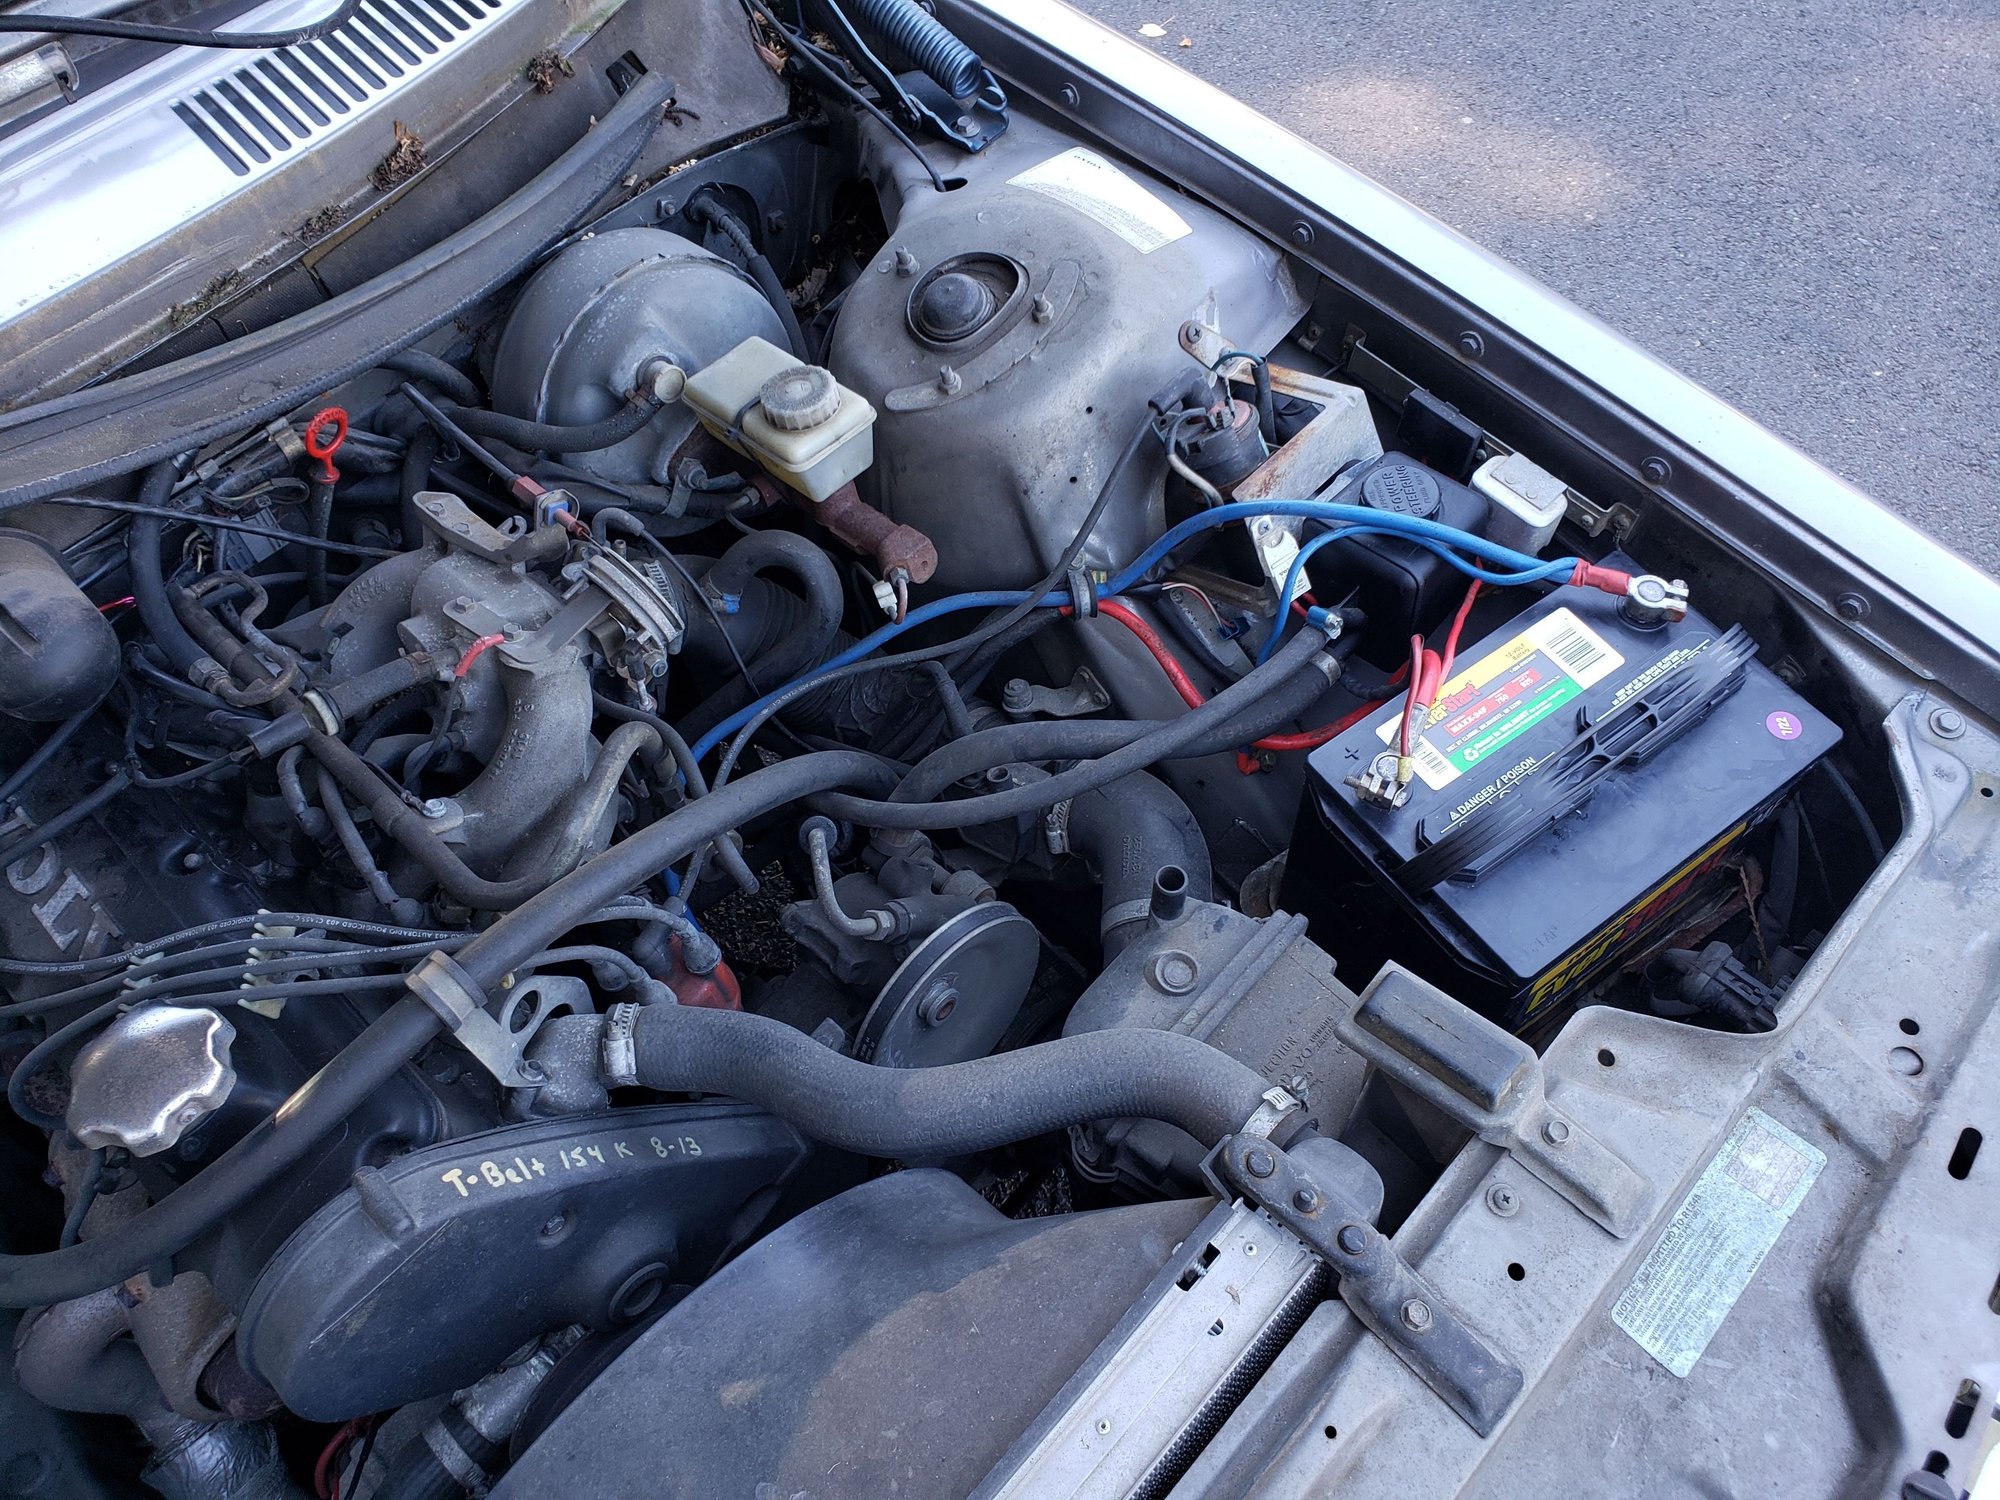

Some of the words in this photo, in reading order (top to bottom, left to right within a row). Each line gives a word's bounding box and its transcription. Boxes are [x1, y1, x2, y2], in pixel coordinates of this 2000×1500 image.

[1381, 471, 1407, 512] POWER
[1394, 465, 1423, 514] STEERING
[1493, 691, 1511, 707] 750
[1775, 716, 1793, 735] 7/22
[1454, 783, 1497, 816] DANGER
[1499, 754, 1537, 785] POISON
[207, 923, 218, 932] 403
[325, 919, 340, 927] 403
[341, 921, 387, 934] BOUGICORD
[388, 928, 433, 939] AUTORADIO
[559, 1145, 605, 1170] 154
[614, 1141, 634, 1159] K
[1613, 1282, 1643, 1319] NOTICE:
[1672, 1216, 1687, 1231] TO
[1745, 1248, 1766, 1274] VOLVO
